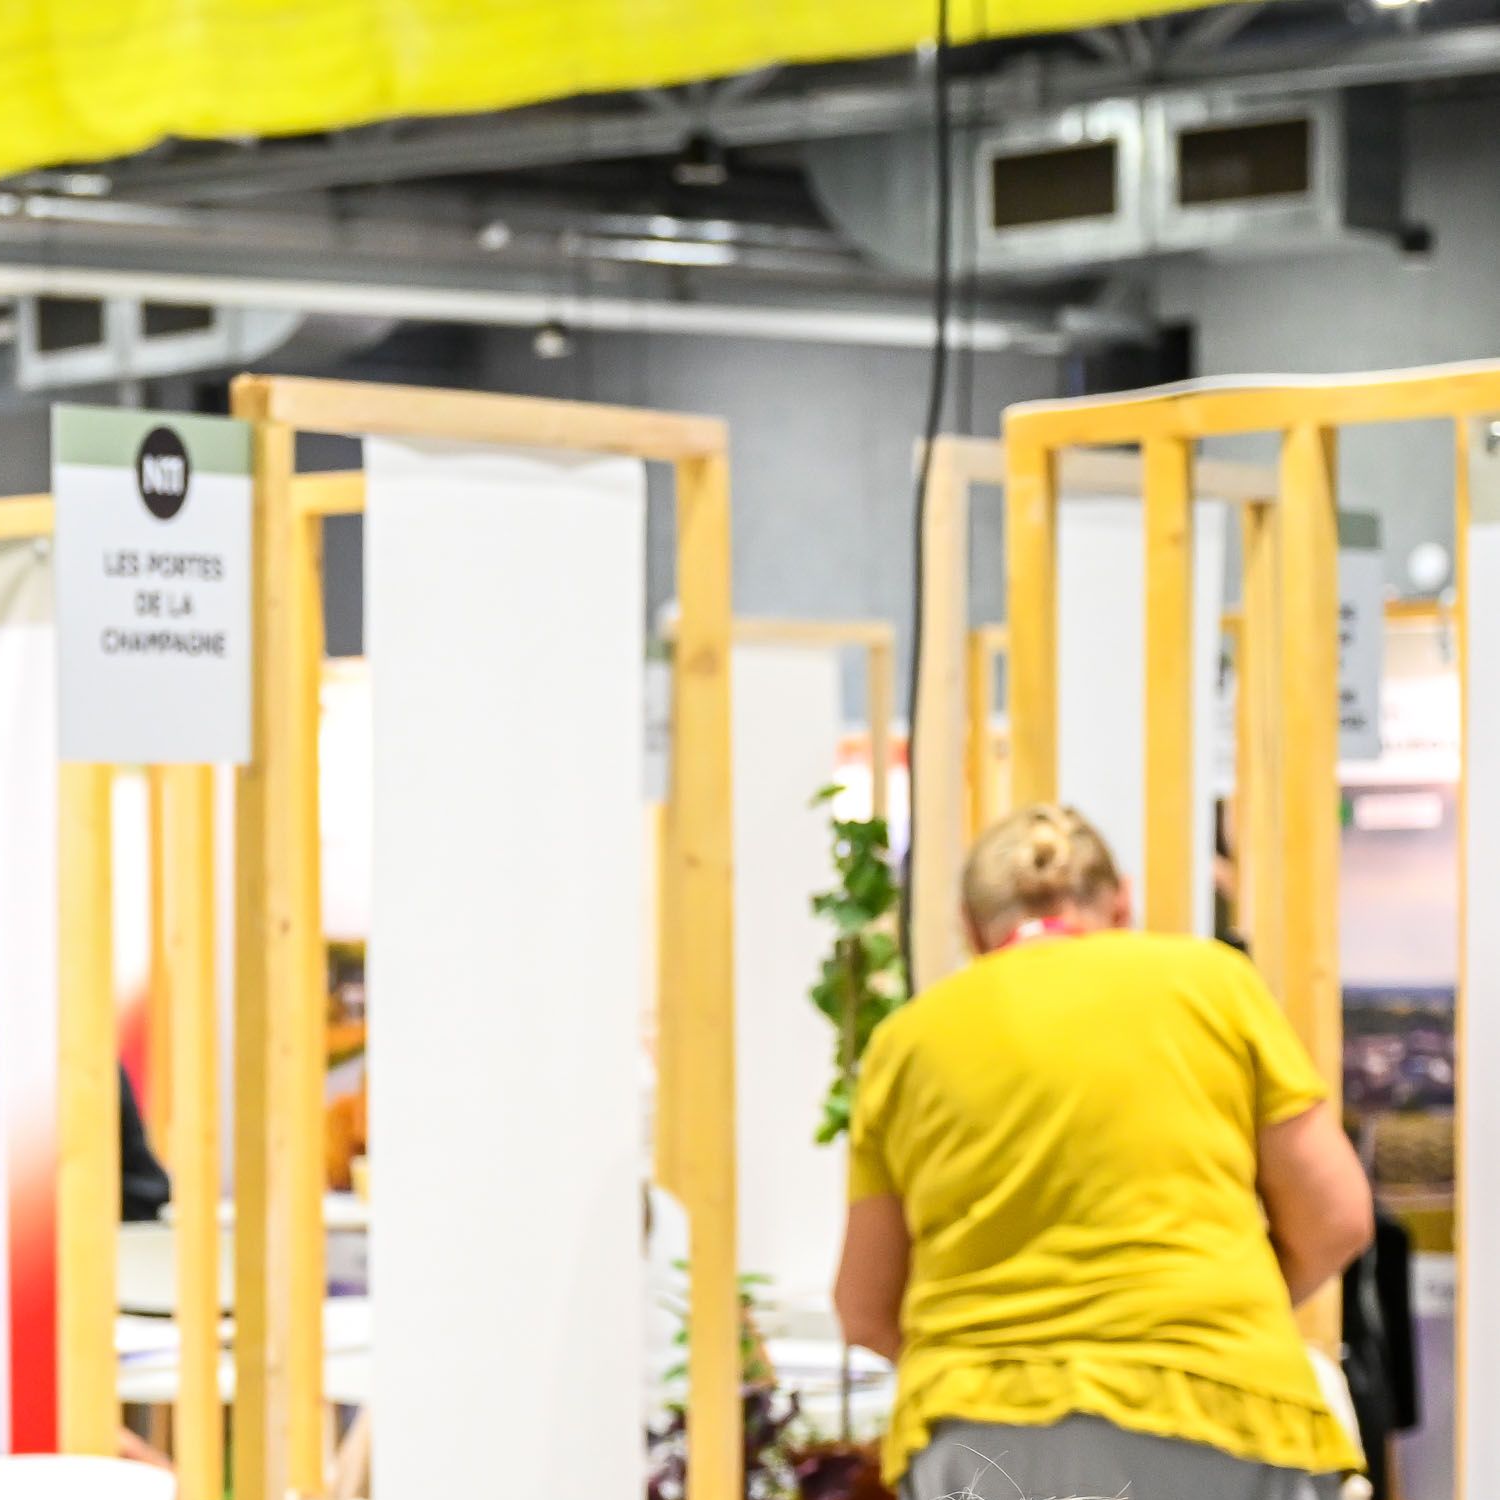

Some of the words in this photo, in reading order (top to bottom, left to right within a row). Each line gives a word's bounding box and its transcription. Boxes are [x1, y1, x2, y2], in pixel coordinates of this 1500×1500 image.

[102, 549, 139, 578] LES
[148, 551, 225, 581] PORTES
[134, 589, 162, 619] DE
[168, 591, 195, 618] LA
[100, 625, 228, 659] CHAMPAGNE
